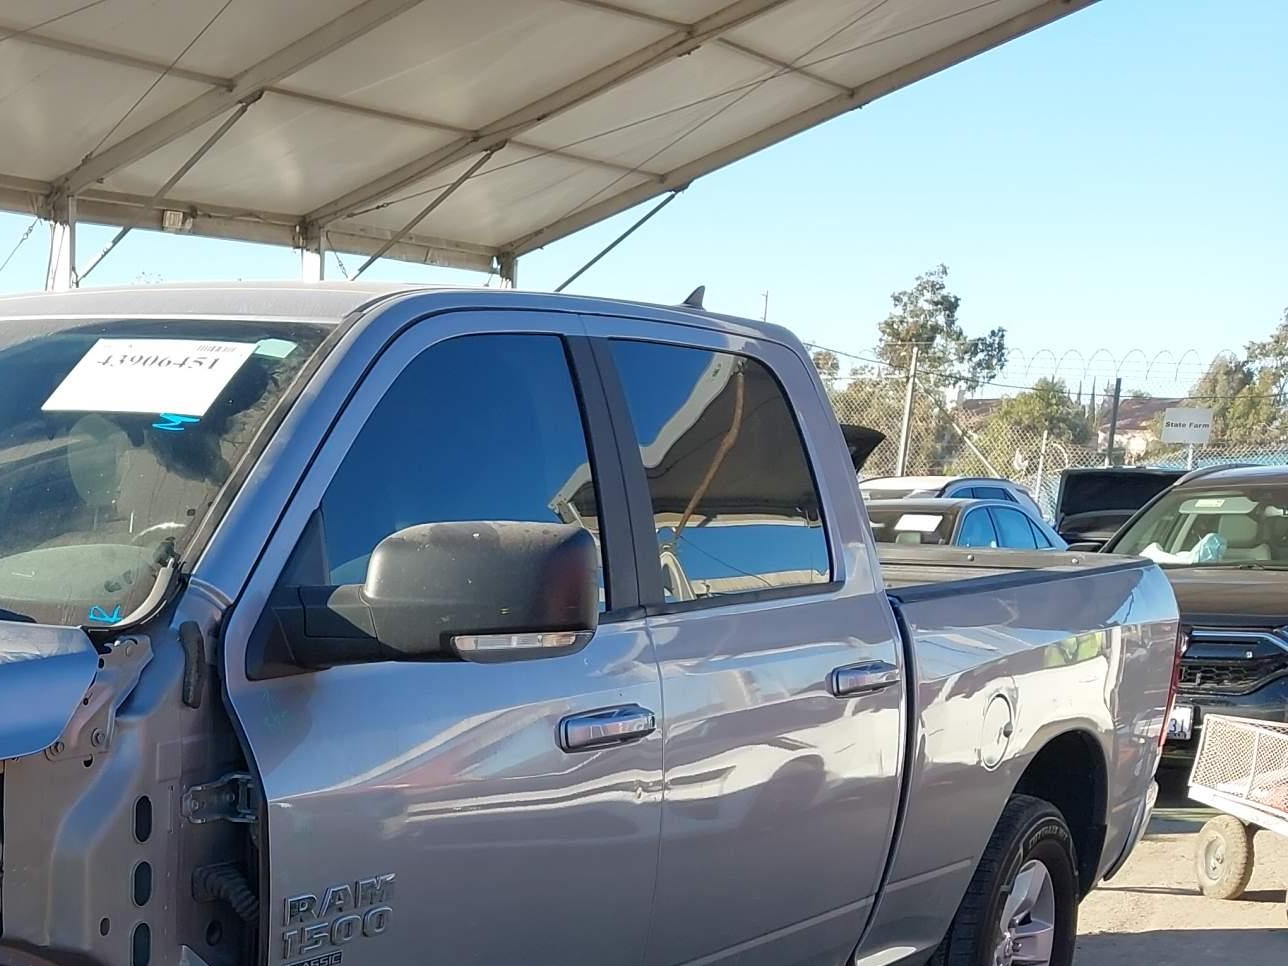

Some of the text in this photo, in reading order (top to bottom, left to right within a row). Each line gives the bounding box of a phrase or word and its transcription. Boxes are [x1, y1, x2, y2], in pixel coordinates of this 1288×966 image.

[97, 354, 221, 370] 43906451
[283, 873, 396, 927] RAM
[282, 906, 393, 959] 1500
